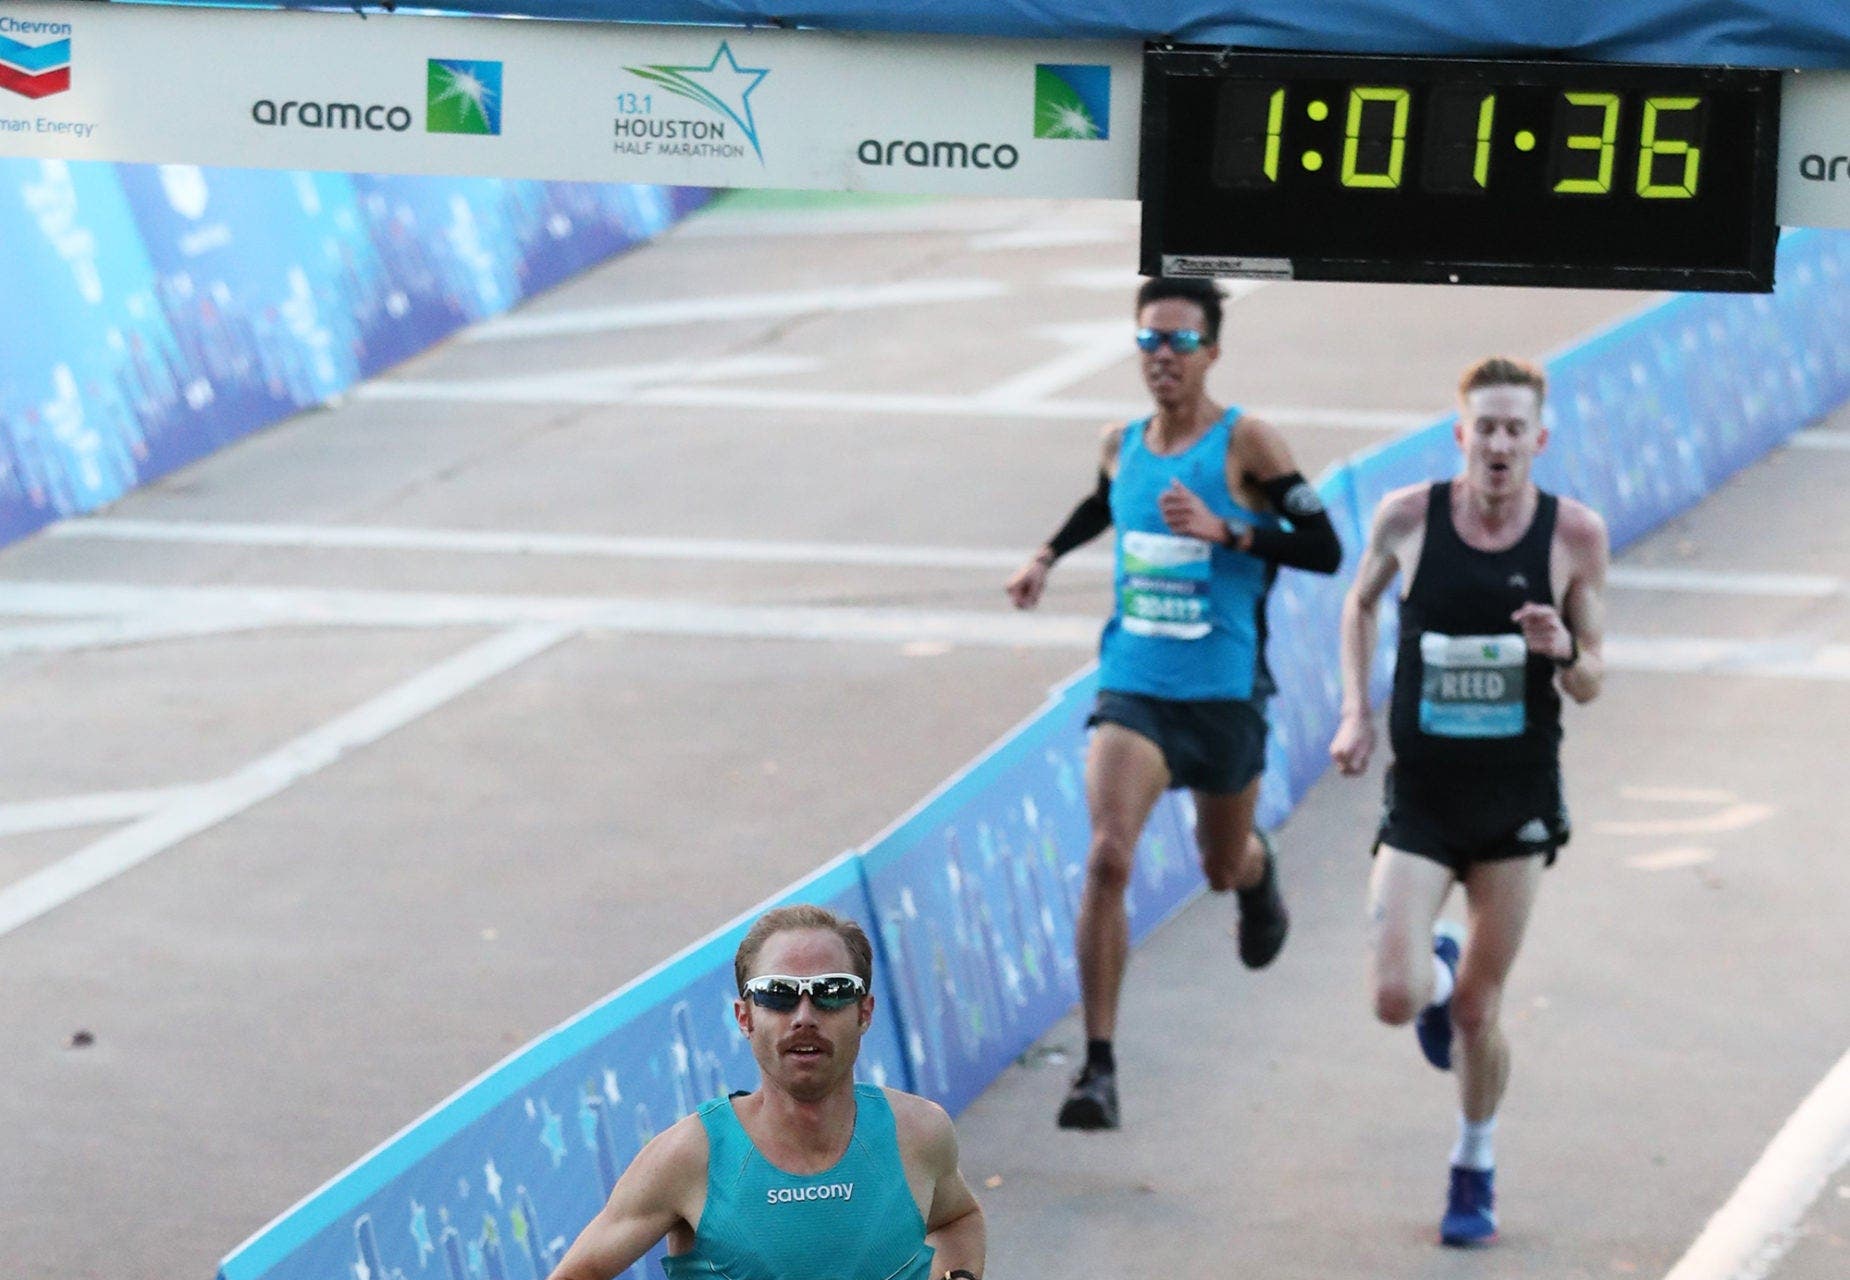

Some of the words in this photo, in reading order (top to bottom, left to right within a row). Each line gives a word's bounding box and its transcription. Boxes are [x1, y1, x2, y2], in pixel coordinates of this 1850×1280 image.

[0, 16, 72, 35] Chevron
[616, 92, 652, 114] 13.1
[252, 99, 412, 132] aramco
[36, 118, 95, 138] Energy
[613, 118, 726, 140] HOUSTON
[613, 141, 652, 156] HALF
[657, 142, 745, 158] MARATHON
[857, 138, 1019, 170] aramco
[1799, 153, 1850, 182] ar
[1442, 671, 1505, 700] REED
[766, 1182, 854, 1204] saucony
